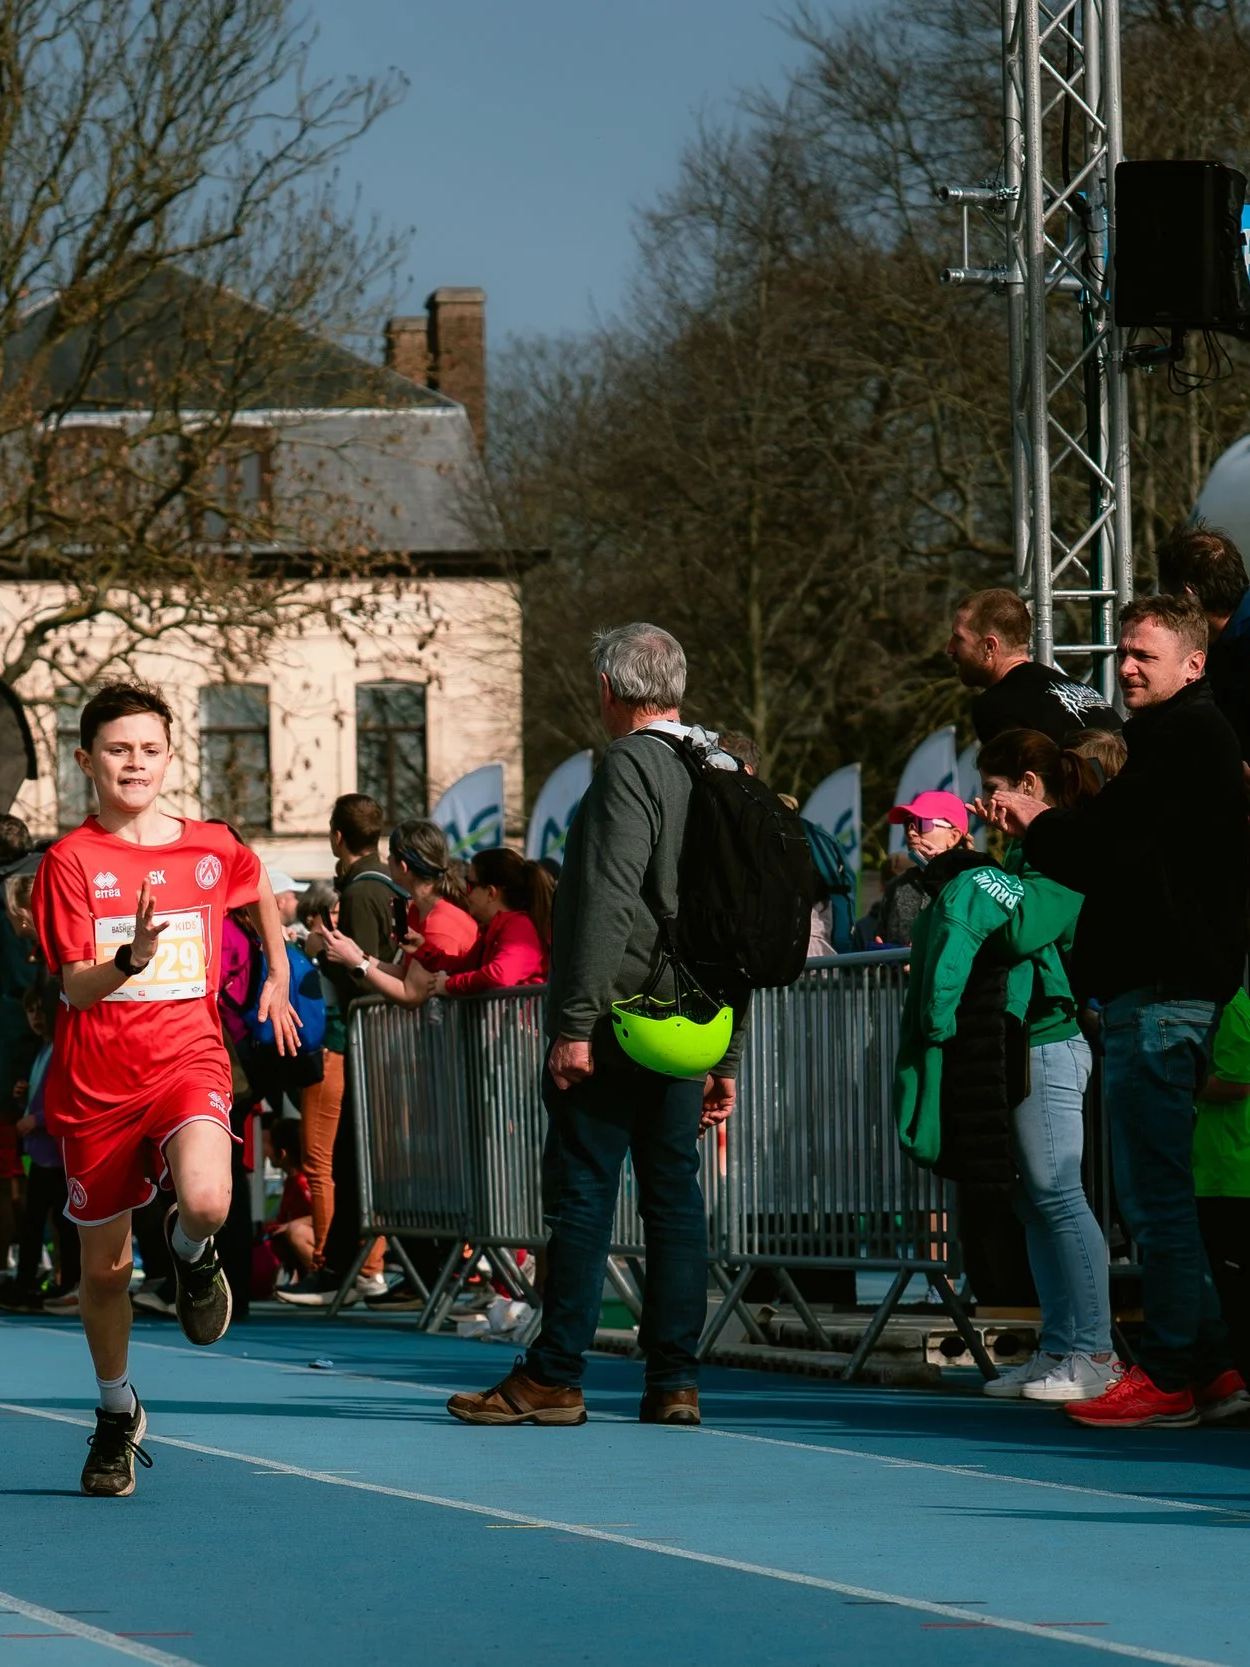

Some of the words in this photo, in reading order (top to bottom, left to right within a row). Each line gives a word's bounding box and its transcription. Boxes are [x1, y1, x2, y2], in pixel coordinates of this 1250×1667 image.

[149, 870, 166, 885] SK
[95, 888, 121, 898] errea
[175, 920, 197, 931] KIDS
